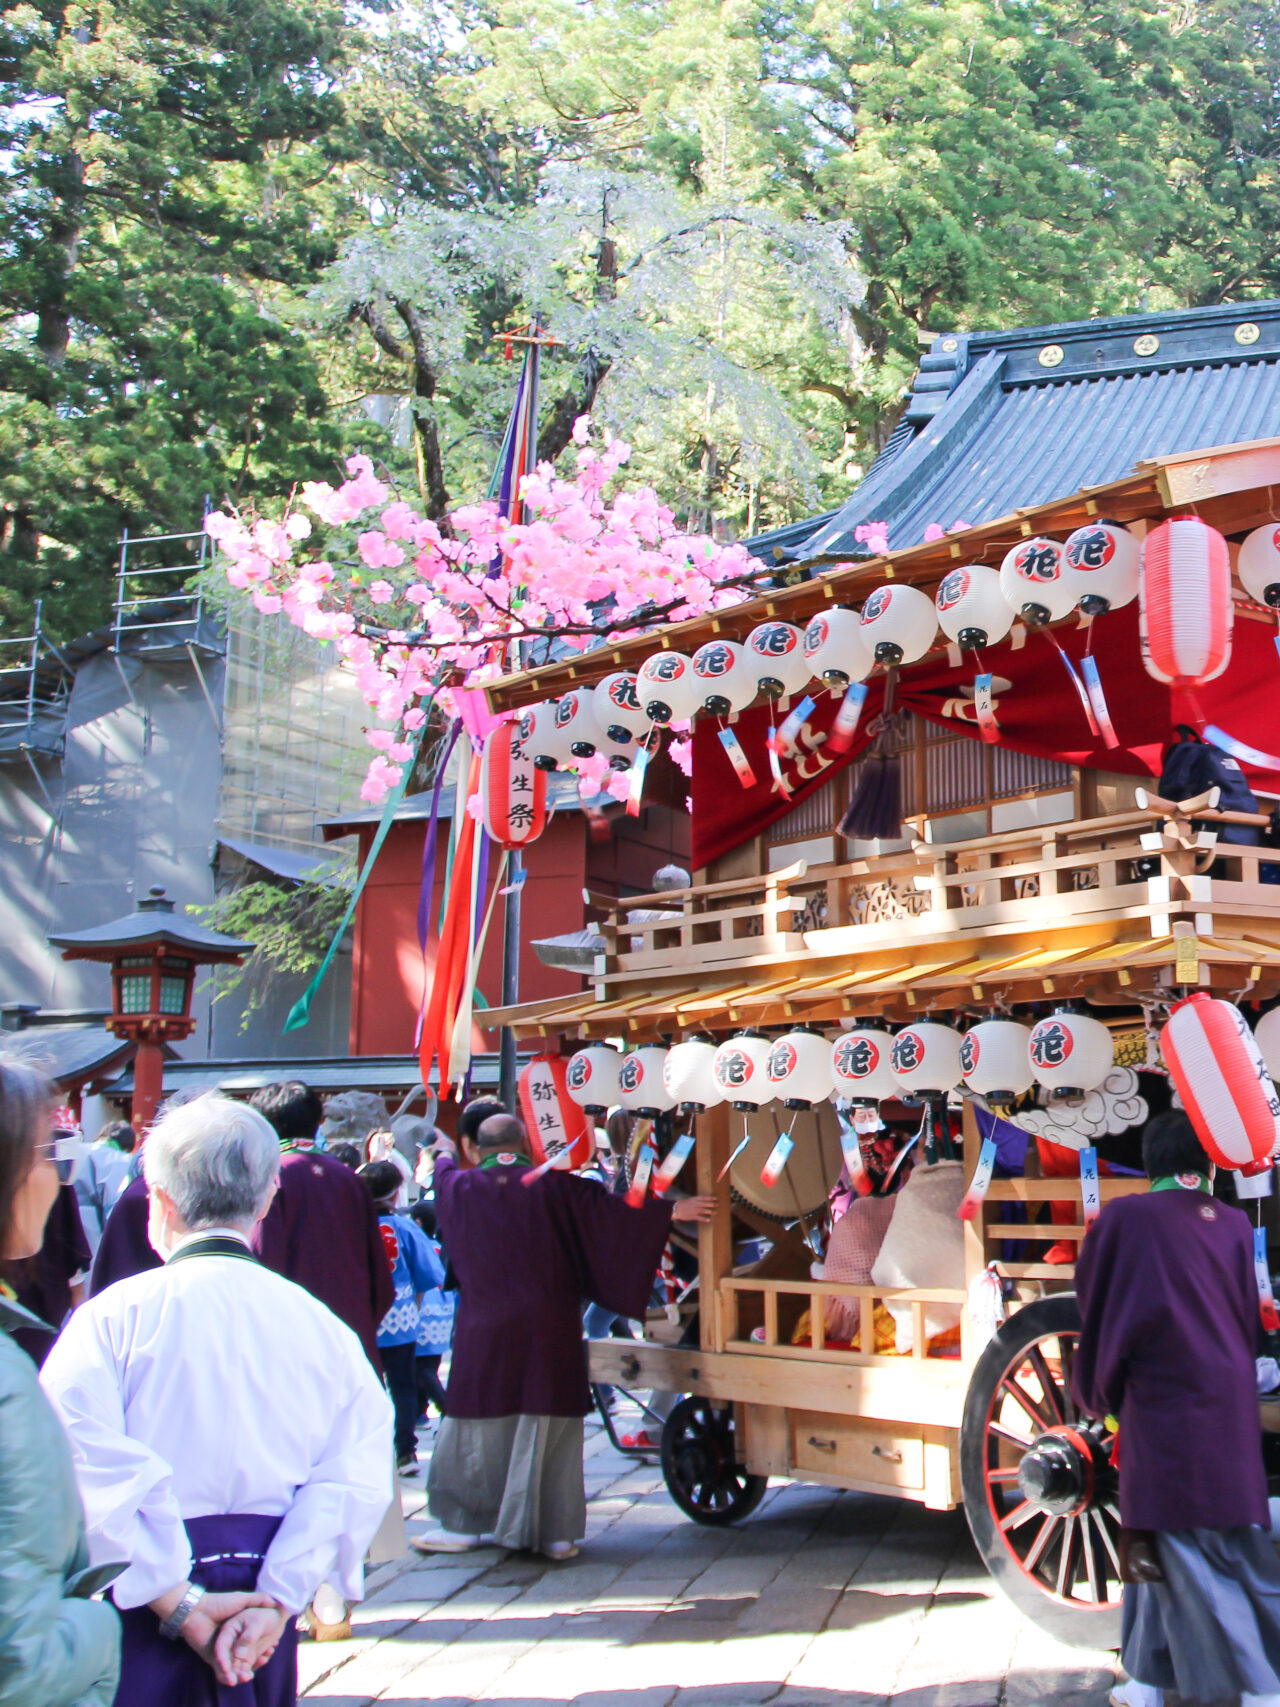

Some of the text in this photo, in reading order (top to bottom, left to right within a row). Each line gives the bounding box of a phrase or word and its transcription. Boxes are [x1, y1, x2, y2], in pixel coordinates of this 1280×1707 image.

[1021, 547, 1057, 578] 花
[1070, 531, 1110, 566] 花
[938, 572, 963, 606] 花
[754, 626, 792, 653] 花
[646, 656, 679, 679] 花
[697, 648, 729, 674] 花
[839, 1040, 873, 1075] 花
[892, 1035, 918, 1070] 花
[1032, 1025, 1065, 1063] 花
[568, 1058, 587, 1087] 花
[619, 1060, 638, 1090] 花
[718, 1053, 747, 1084] 花
[768, 1045, 792, 1080] 花
